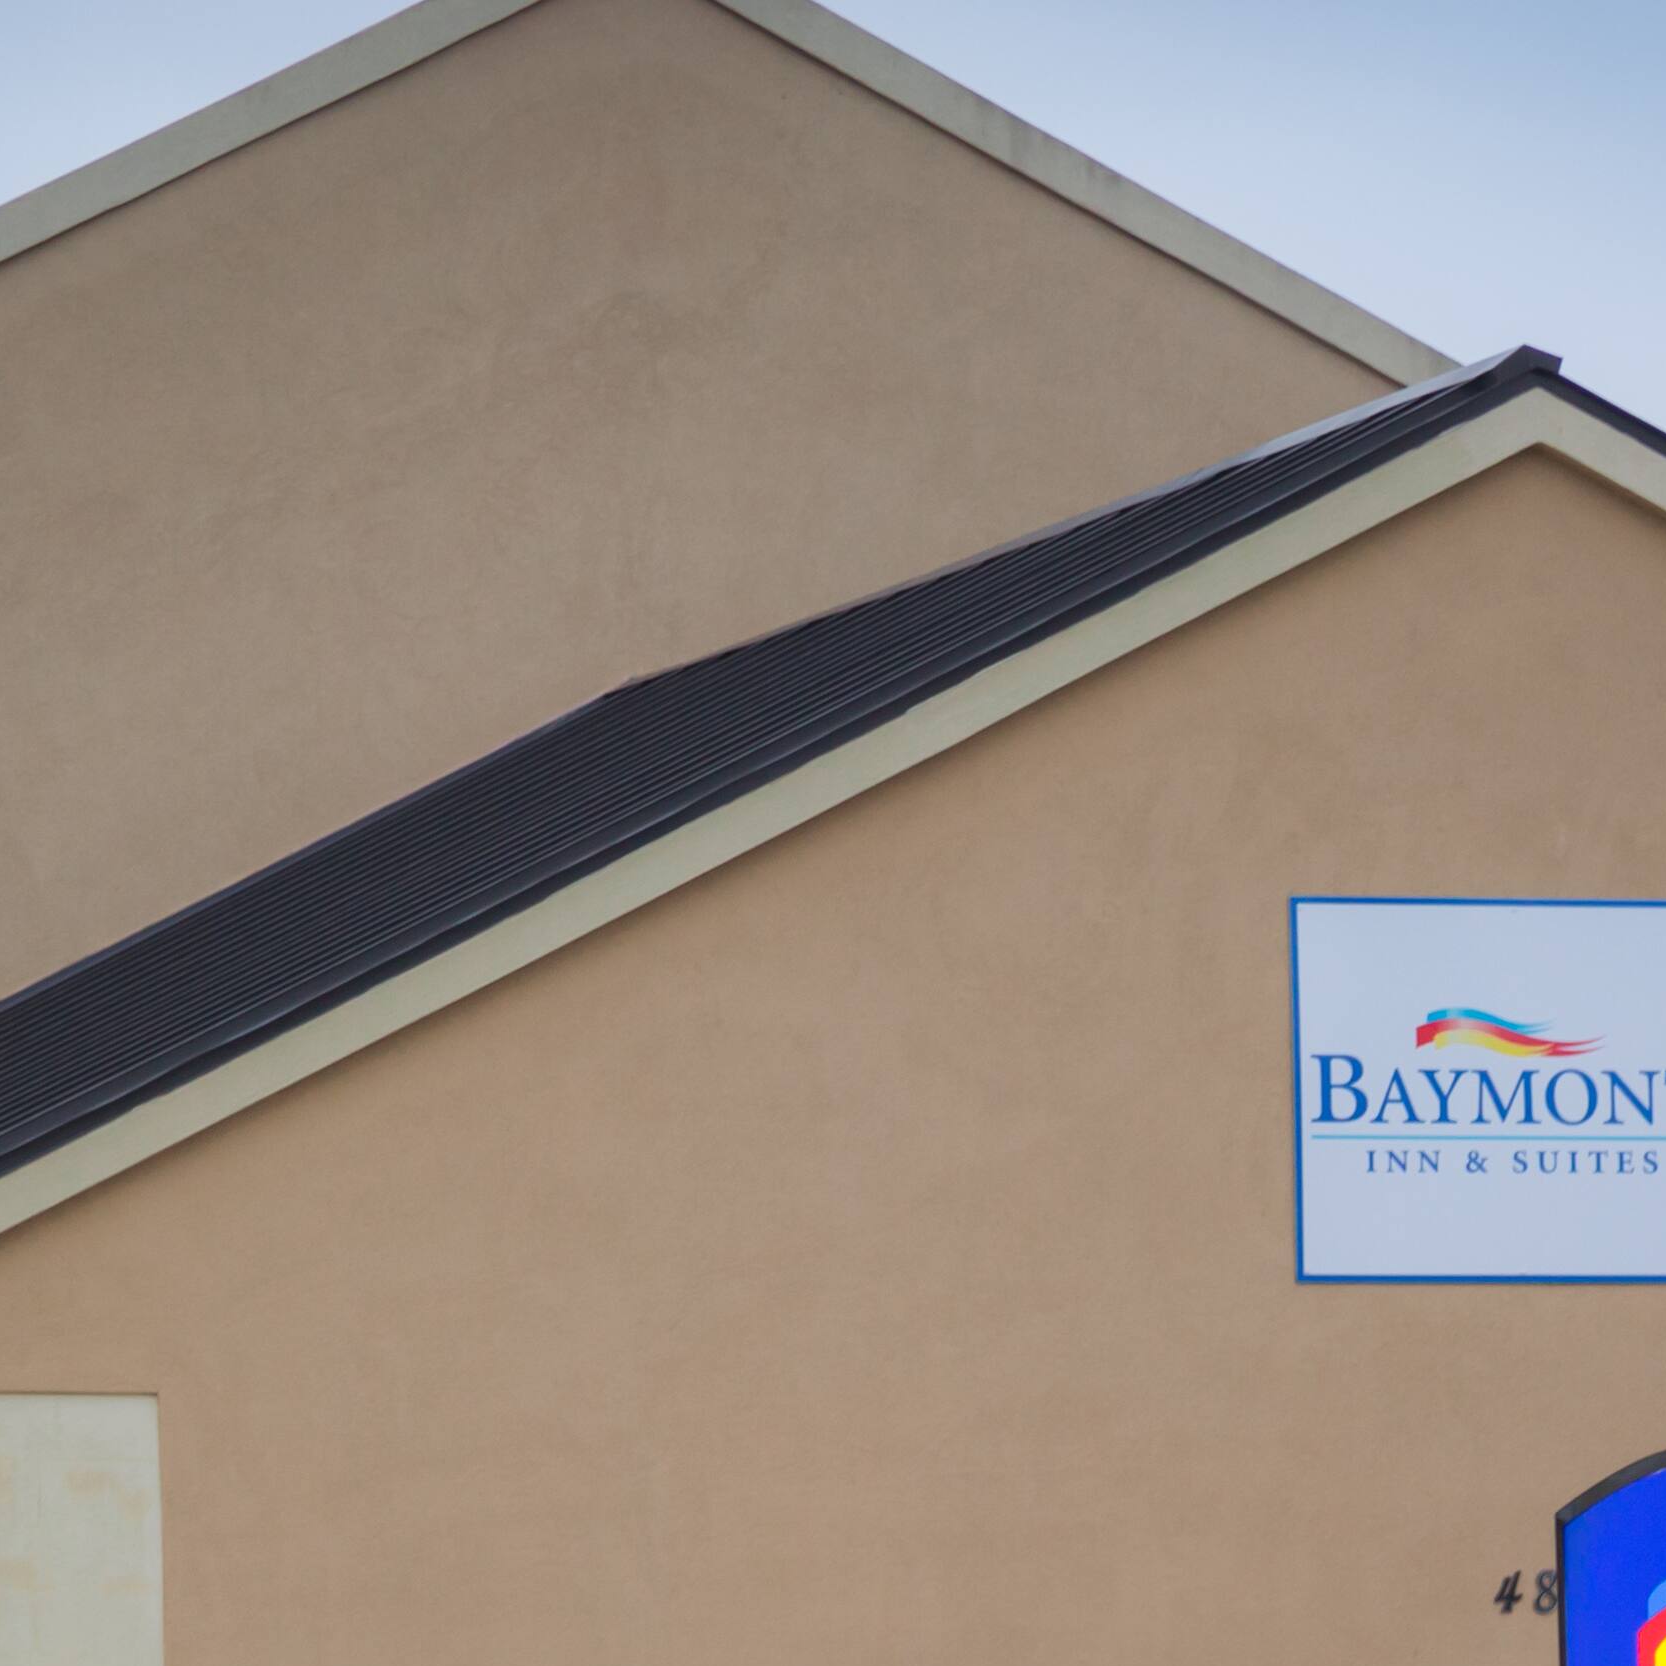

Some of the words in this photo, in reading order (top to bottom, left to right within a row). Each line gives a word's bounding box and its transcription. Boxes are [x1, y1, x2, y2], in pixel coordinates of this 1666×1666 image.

[1366, 1151, 1441, 1173] INN
[1466, 1151, 1488, 1174] &
[1513, 1151, 1659, 1174] SUITES
